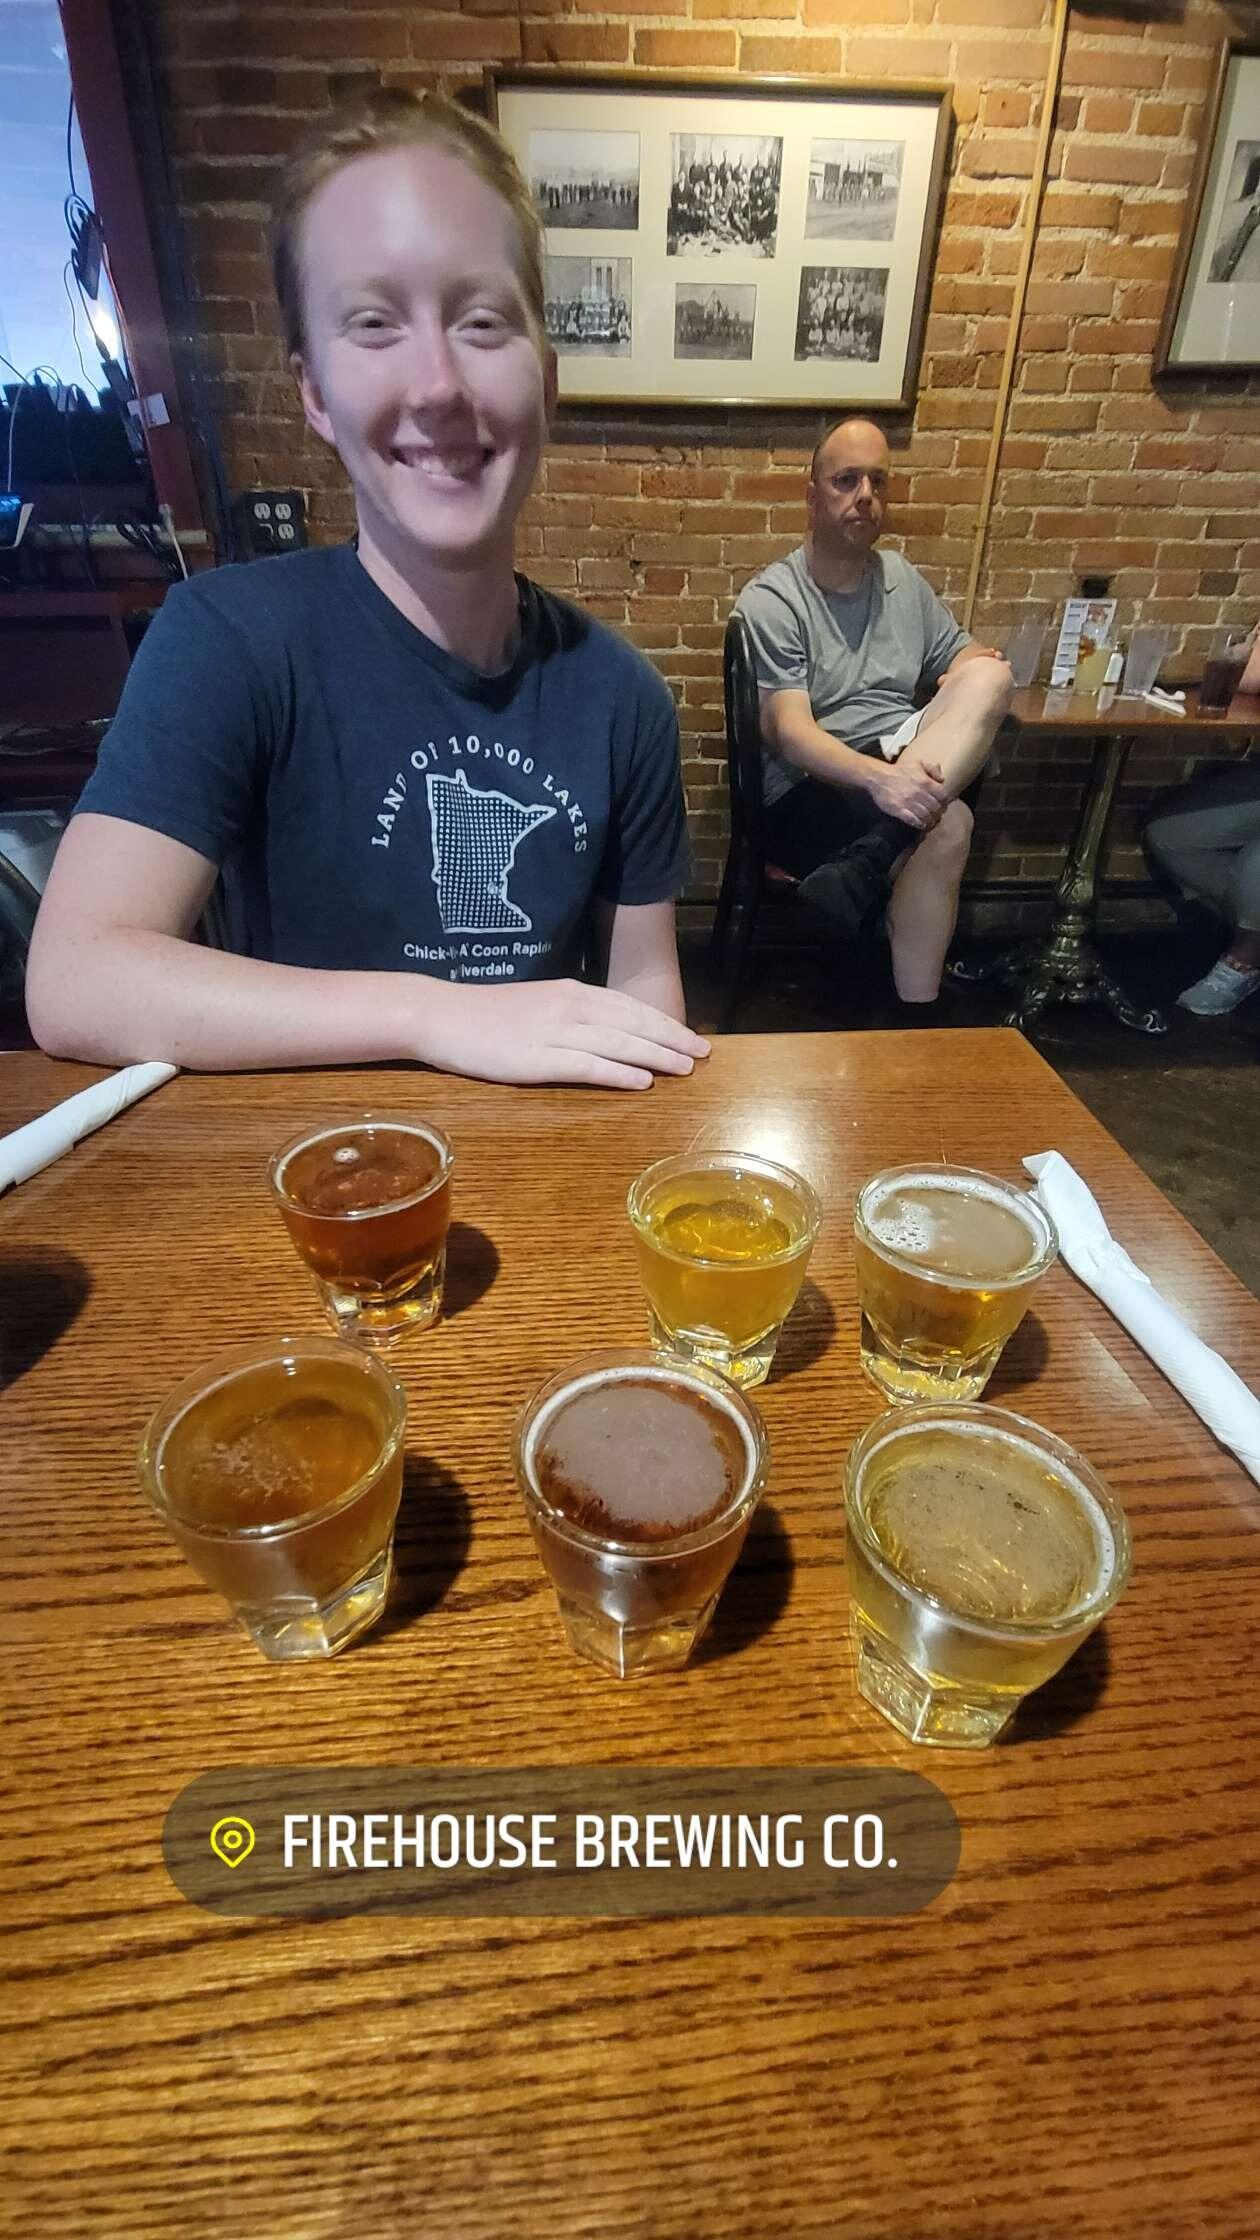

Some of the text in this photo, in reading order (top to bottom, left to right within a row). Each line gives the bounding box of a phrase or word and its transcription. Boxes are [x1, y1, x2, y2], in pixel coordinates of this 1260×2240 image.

[371, 772, 407, 849] LAND
[448, 735, 535, 774] 10,000
[542, 774, 588, 853] LAKES
[403, 942, 468, 961] Chick--A
[471, 944, 508, 957] Coon
[460, 961, 515, 978] iverdale
